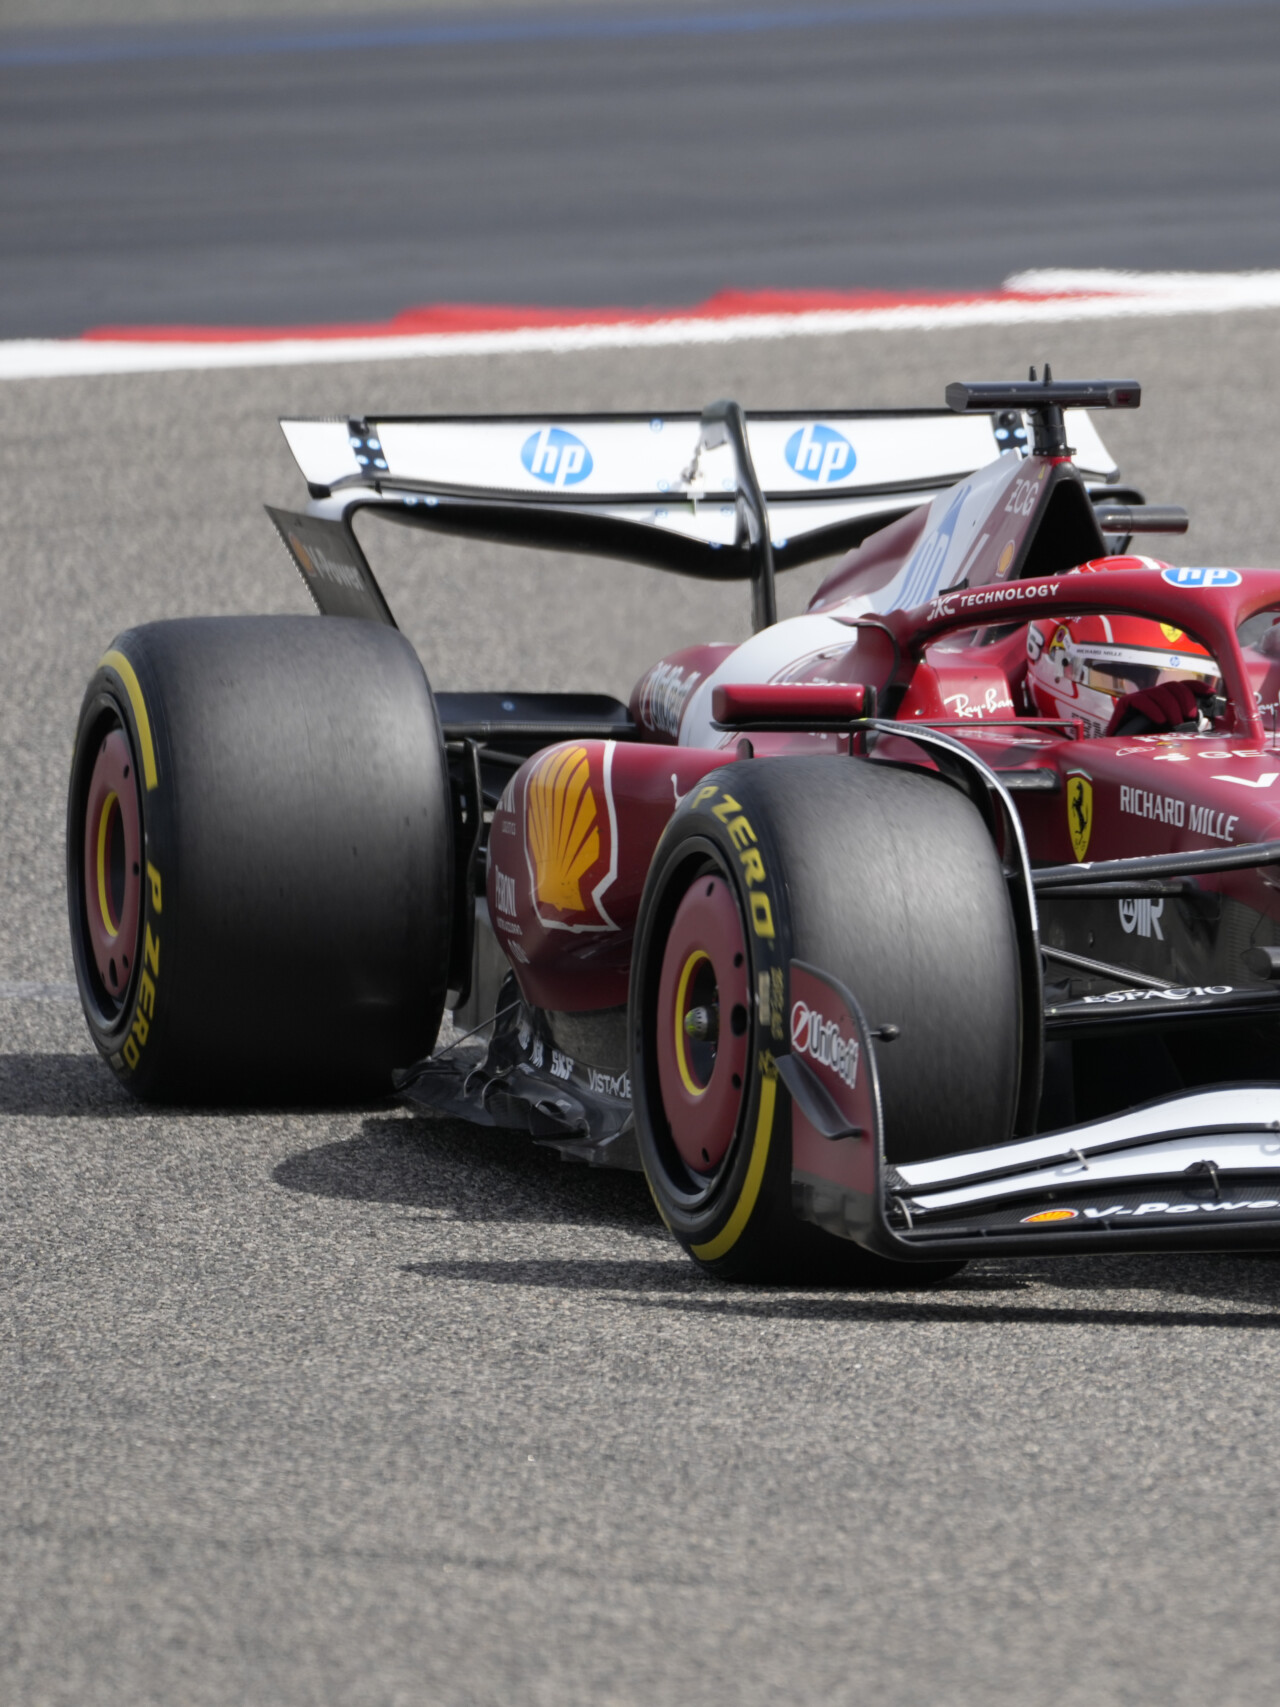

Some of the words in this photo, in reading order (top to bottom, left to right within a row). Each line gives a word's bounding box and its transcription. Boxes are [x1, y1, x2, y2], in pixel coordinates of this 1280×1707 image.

[531, 426, 586, 487] hp
[794, 422, 850, 483] hp
[961, 582, 1061, 607] TECHNOLOGY
[1177, 567, 1228, 586] hp
[943, 688, 1014, 719] Ray-Ban
[1120, 785, 1185, 828] RICHARD
[1188, 804, 1239, 842] MILLE
[147, 860, 163, 915] P
[711, 794, 776, 939] ZERO
[123, 921, 160, 1070] ZERO
[550, 1049, 575, 1081] SKF
[587, 1067, 632, 1099] VISTAJE
